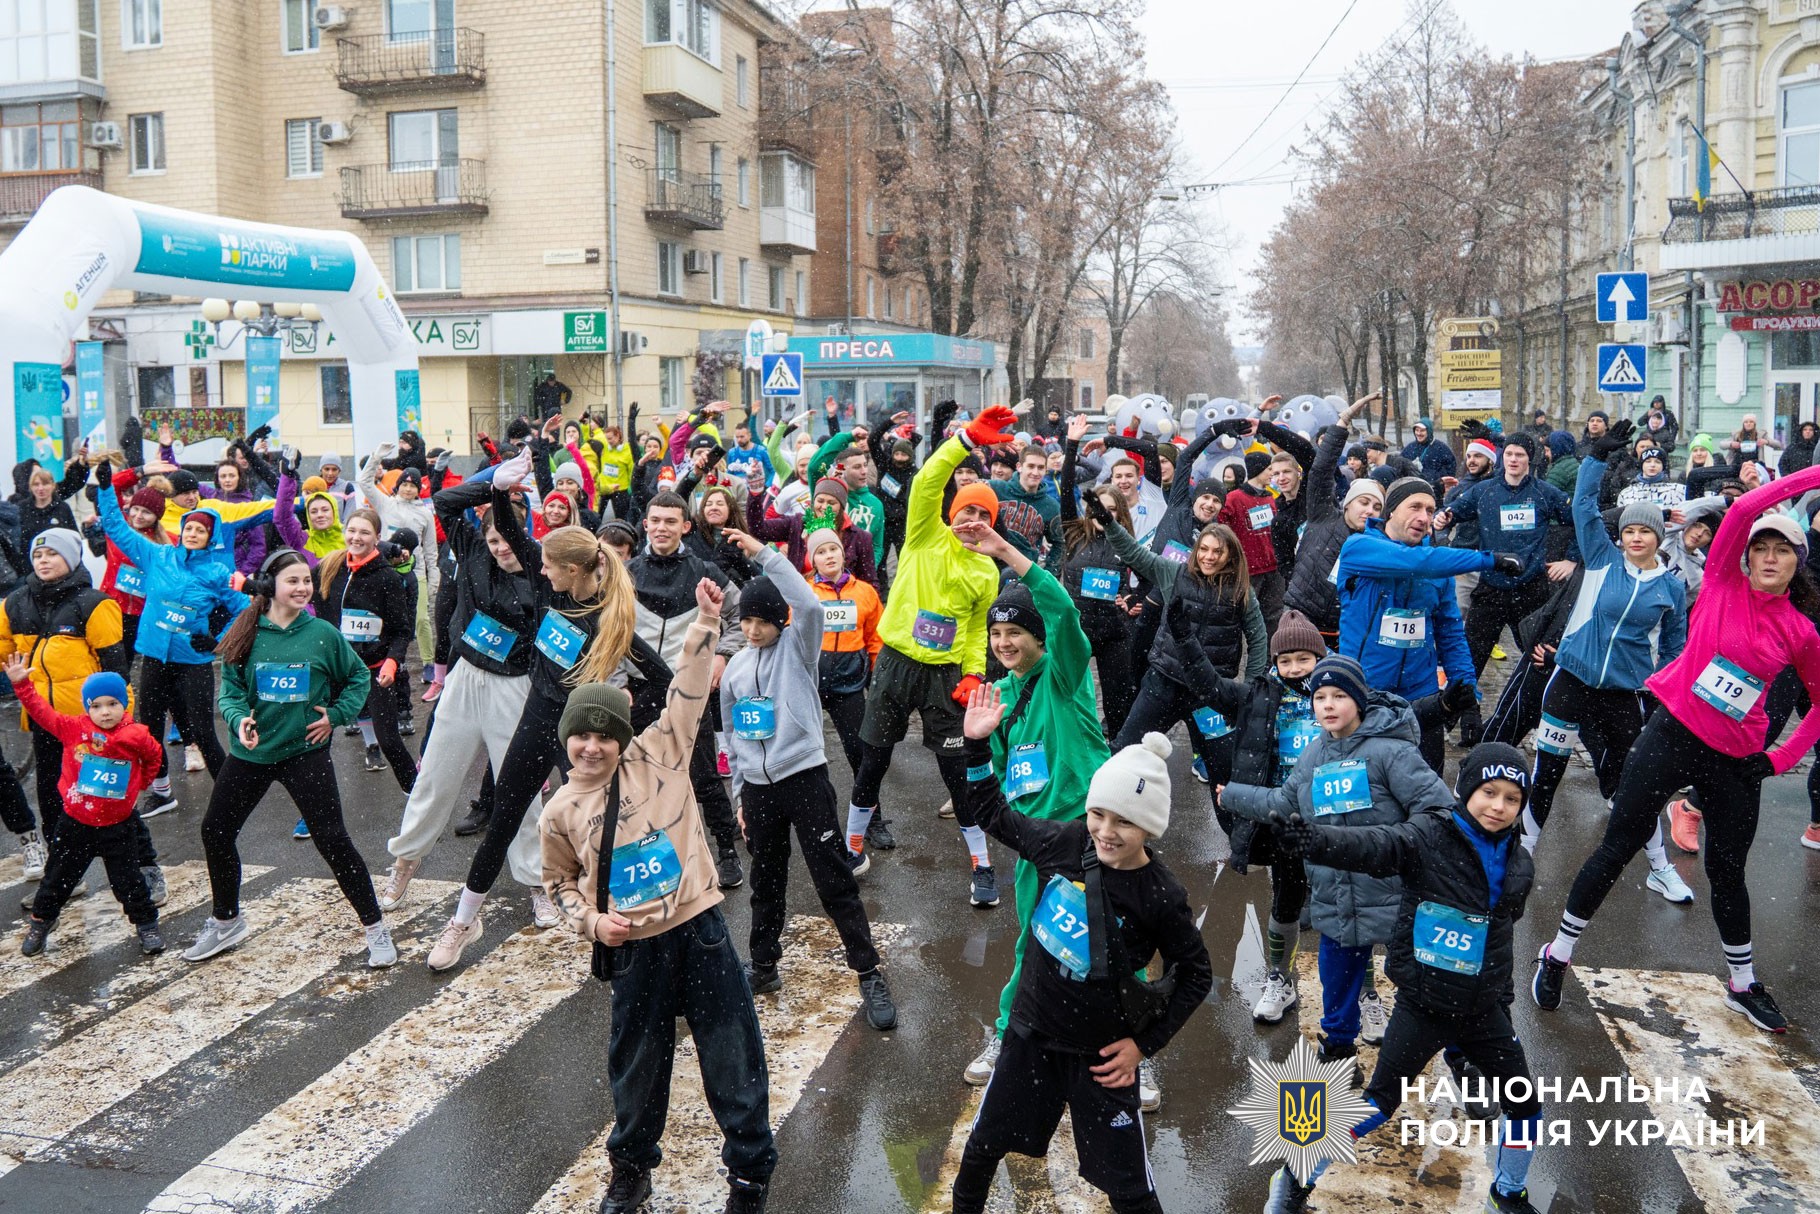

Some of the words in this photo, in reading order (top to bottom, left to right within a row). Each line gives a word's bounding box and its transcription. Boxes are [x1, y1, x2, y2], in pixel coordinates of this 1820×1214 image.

[240, 236, 298, 257] АКТИВНІ
[241, 250, 288, 270] ПАРКИ
[568, 336, 604, 345] АПТЕКА
[820, 341, 894, 359] ПРЕСА
[1507, 512, 1525, 521] 042
[123, 574, 141, 586] 741
[1092, 578, 1111, 590] 708
[165, 610, 186, 624] 789
[826, 610, 846, 620] 092
[350, 620, 370, 631] 144
[921, 623, 945, 638] 331
[1393, 622, 1416, 634] 118
[478, 626, 502, 646] 749
[548, 628, 570, 651] 732
[270, 676, 297, 689] 762
[1714, 675, 1743, 698] 119
[1545, 728, 1567, 743] 148
[92, 769, 118, 785] 743
[1481, 764, 1526, 787] NASA
[1324, 778, 1352, 797] 819
[623, 856, 662, 884] 736
[1051, 904, 1089, 939] 737
[1432, 926, 1473, 951] 785
